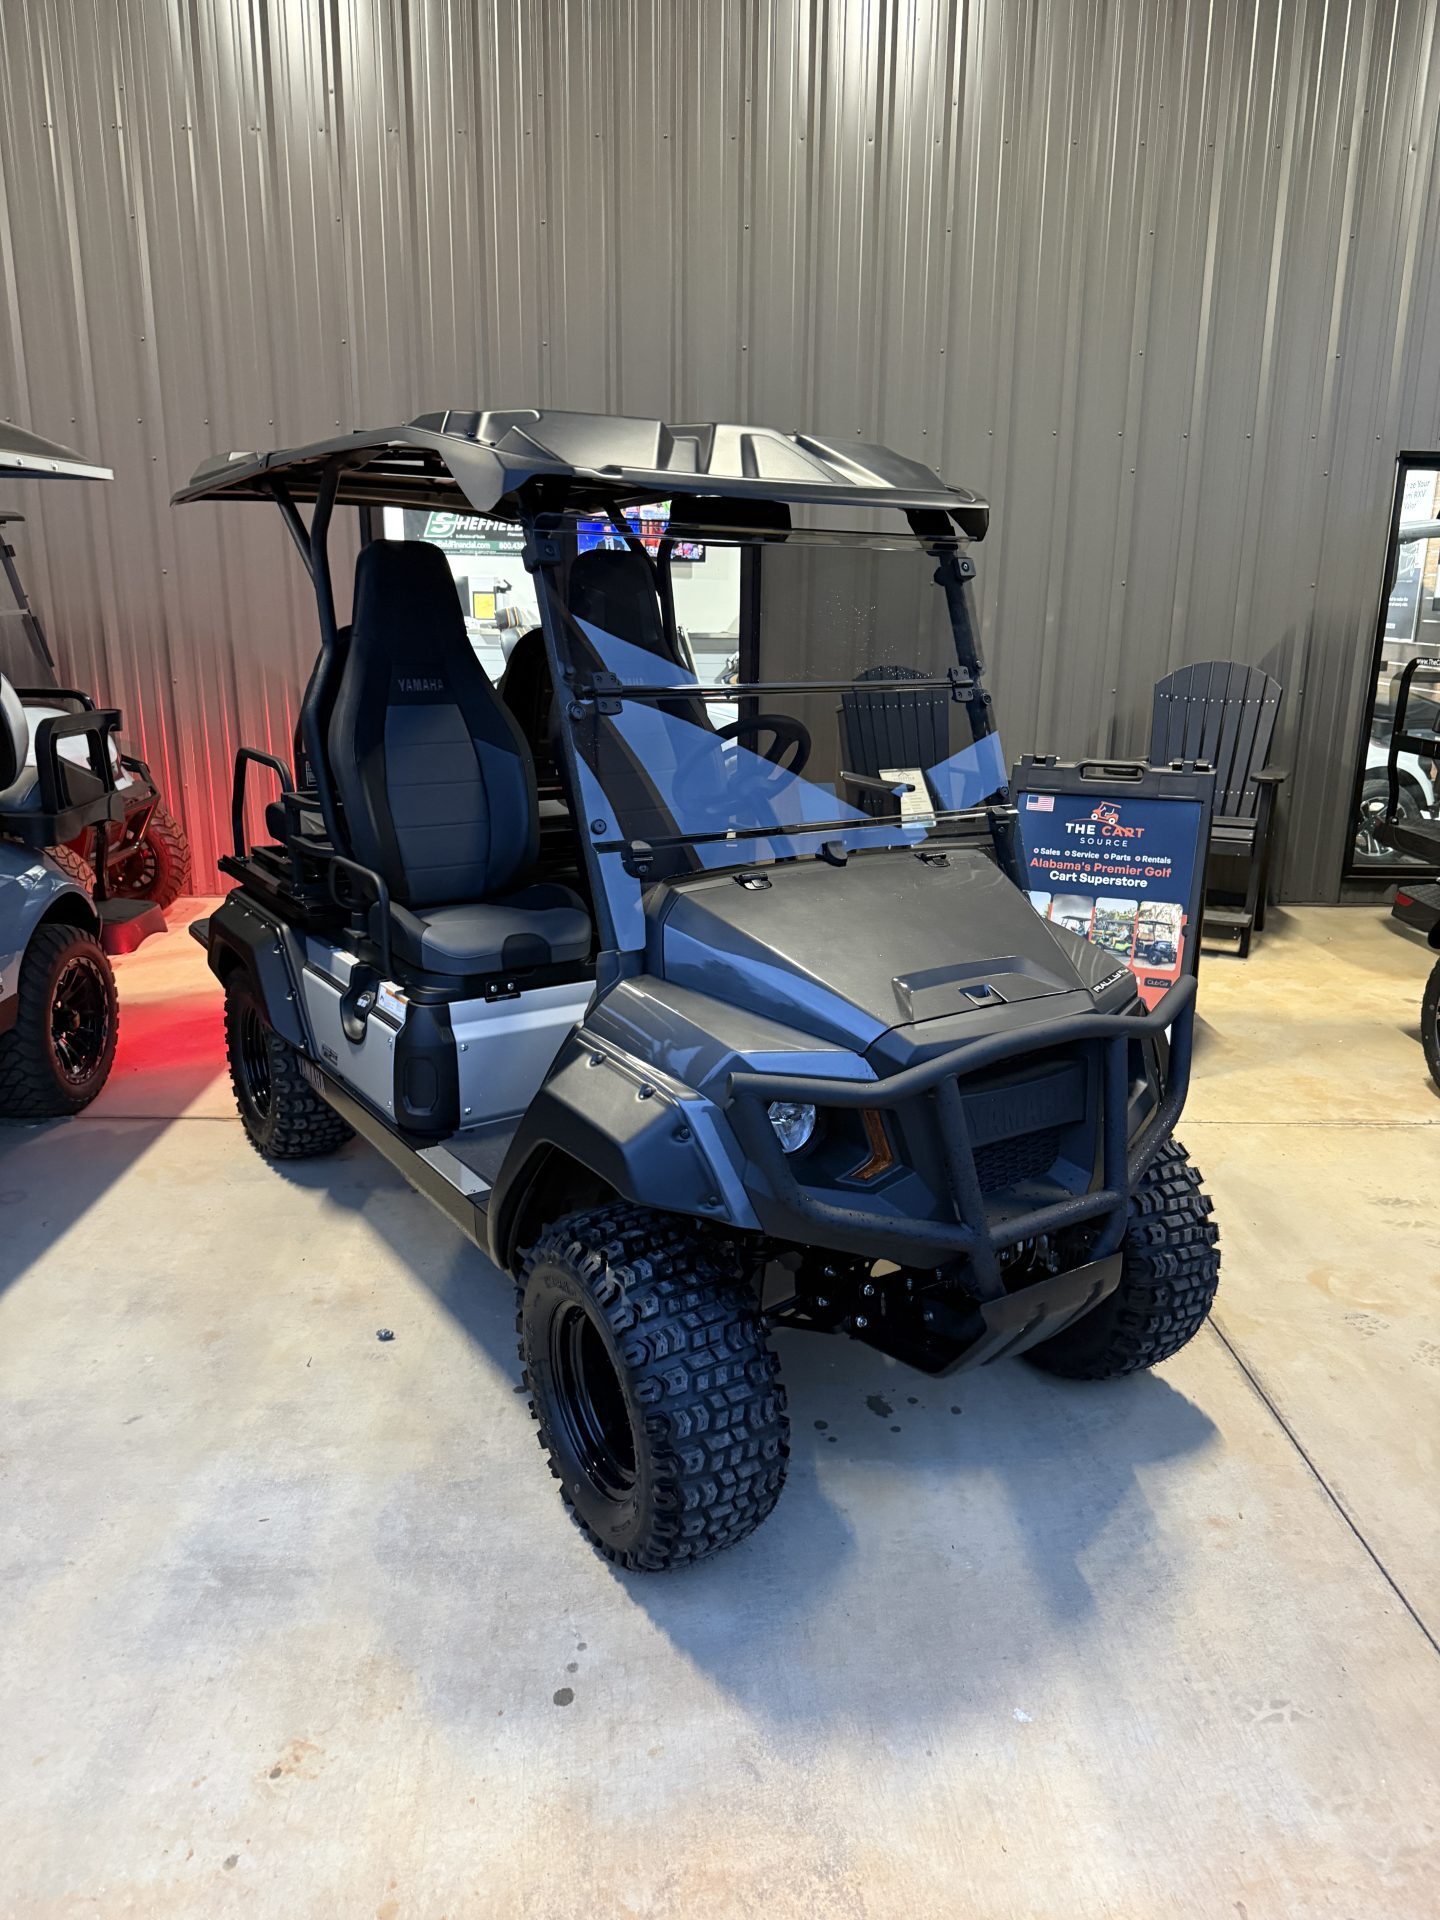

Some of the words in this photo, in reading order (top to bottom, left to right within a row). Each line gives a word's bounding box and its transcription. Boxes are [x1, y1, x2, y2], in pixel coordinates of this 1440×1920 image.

[398, 678, 444, 692] YAMAHA
[1065, 823, 1096, 835] THE
[1102, 826, 1144, 838] CART
[1080, 838, 1127, 847] SOURCE
[1040, 848, 1061, 856] Sales
[1071, 851, 1100, 860] Service
[1110, 853, 1131, 862] Parts
[1141, 855, 1172, 865] Rentals
[1030, 857, 1091, 872] Alabama's
[1093, 863, 1143, 876] Premier
[1144, 866, 1172, 878] Golf
[1049, 870, 1077, 882] Cart
[1079, 873, 1148, 888] Superstore
